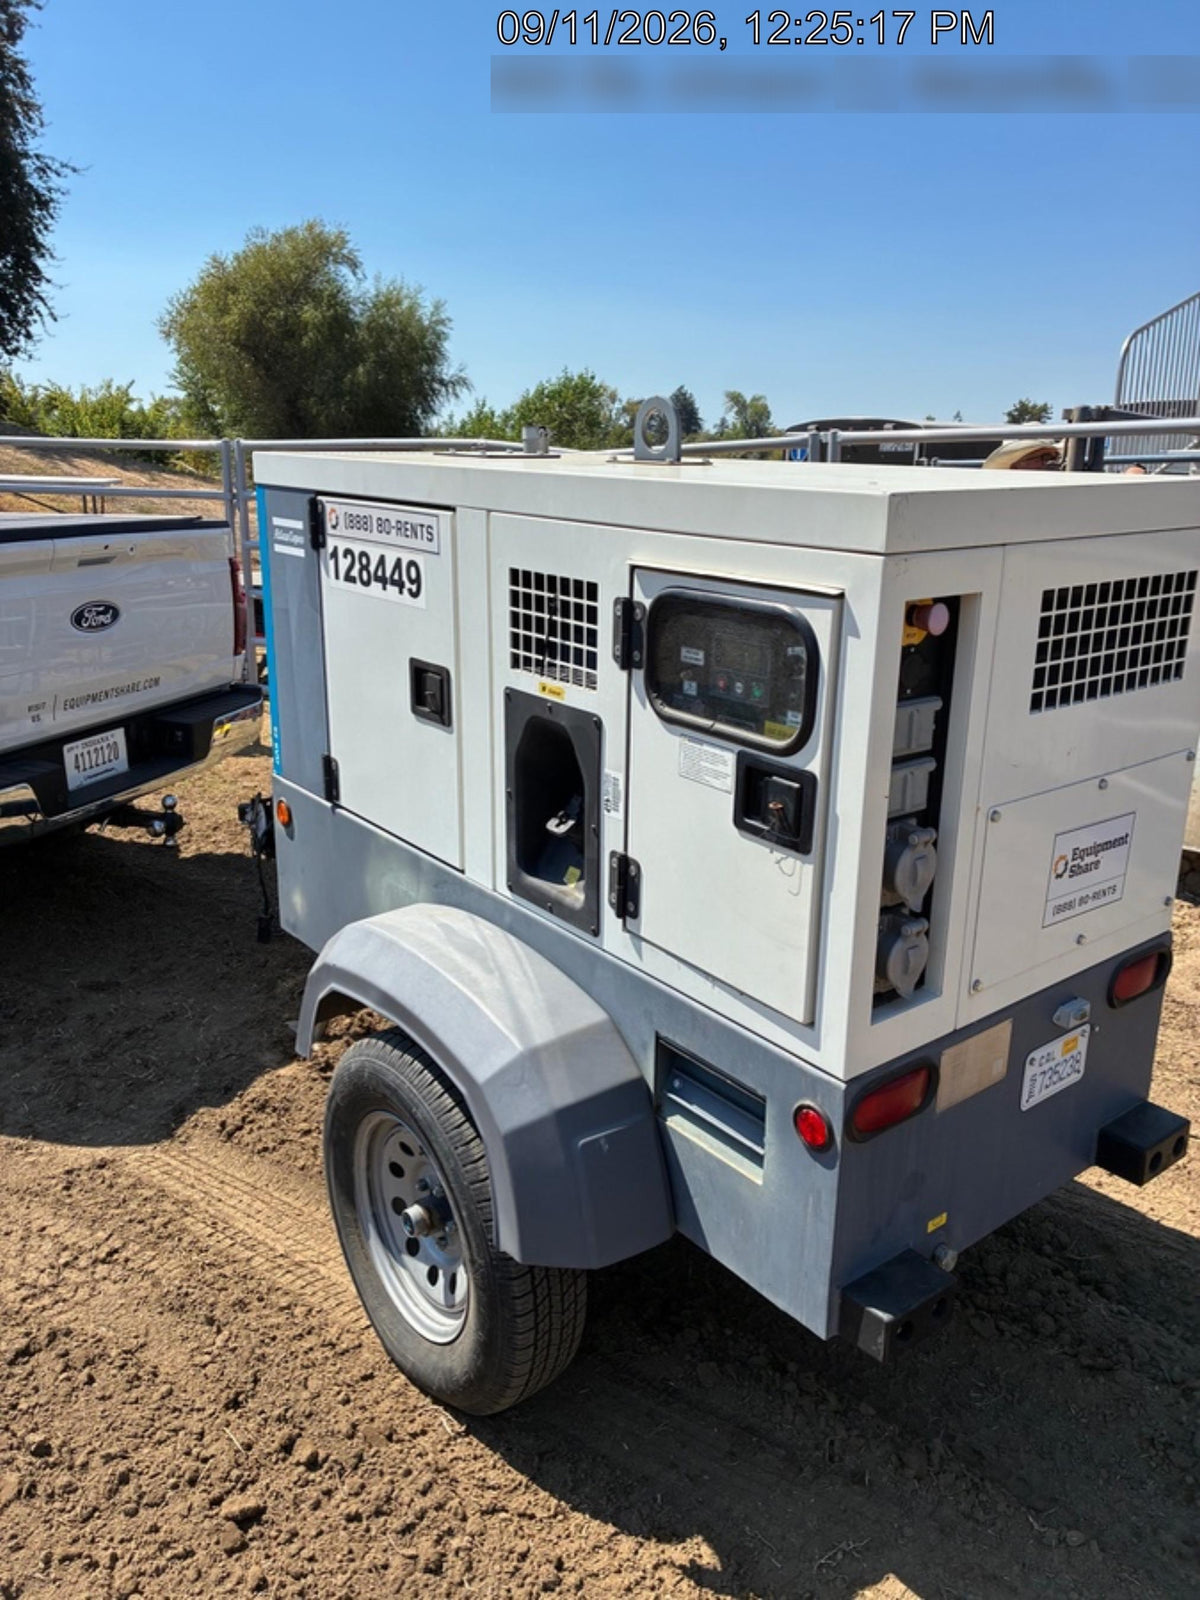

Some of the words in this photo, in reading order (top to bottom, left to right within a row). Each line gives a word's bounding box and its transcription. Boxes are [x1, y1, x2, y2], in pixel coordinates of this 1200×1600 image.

[344, 511, 373, 534] (888)
[376, 517, 434, 543] 80-RENTS
[329, 545, 422, 599] 128449
[81, 606, 113, 627] Ford
[63, 676, 161, 711] EQUIPMENTSHARE.COM
[74, 740, 120, 773] 4112120
[1071, 832, 1130, 862] Equipment
[1068, 859, 1101, 879] Share
[1052, 897, 1076, 916] (888)
[1078, 884, 1118, 907] 80-RENTS
